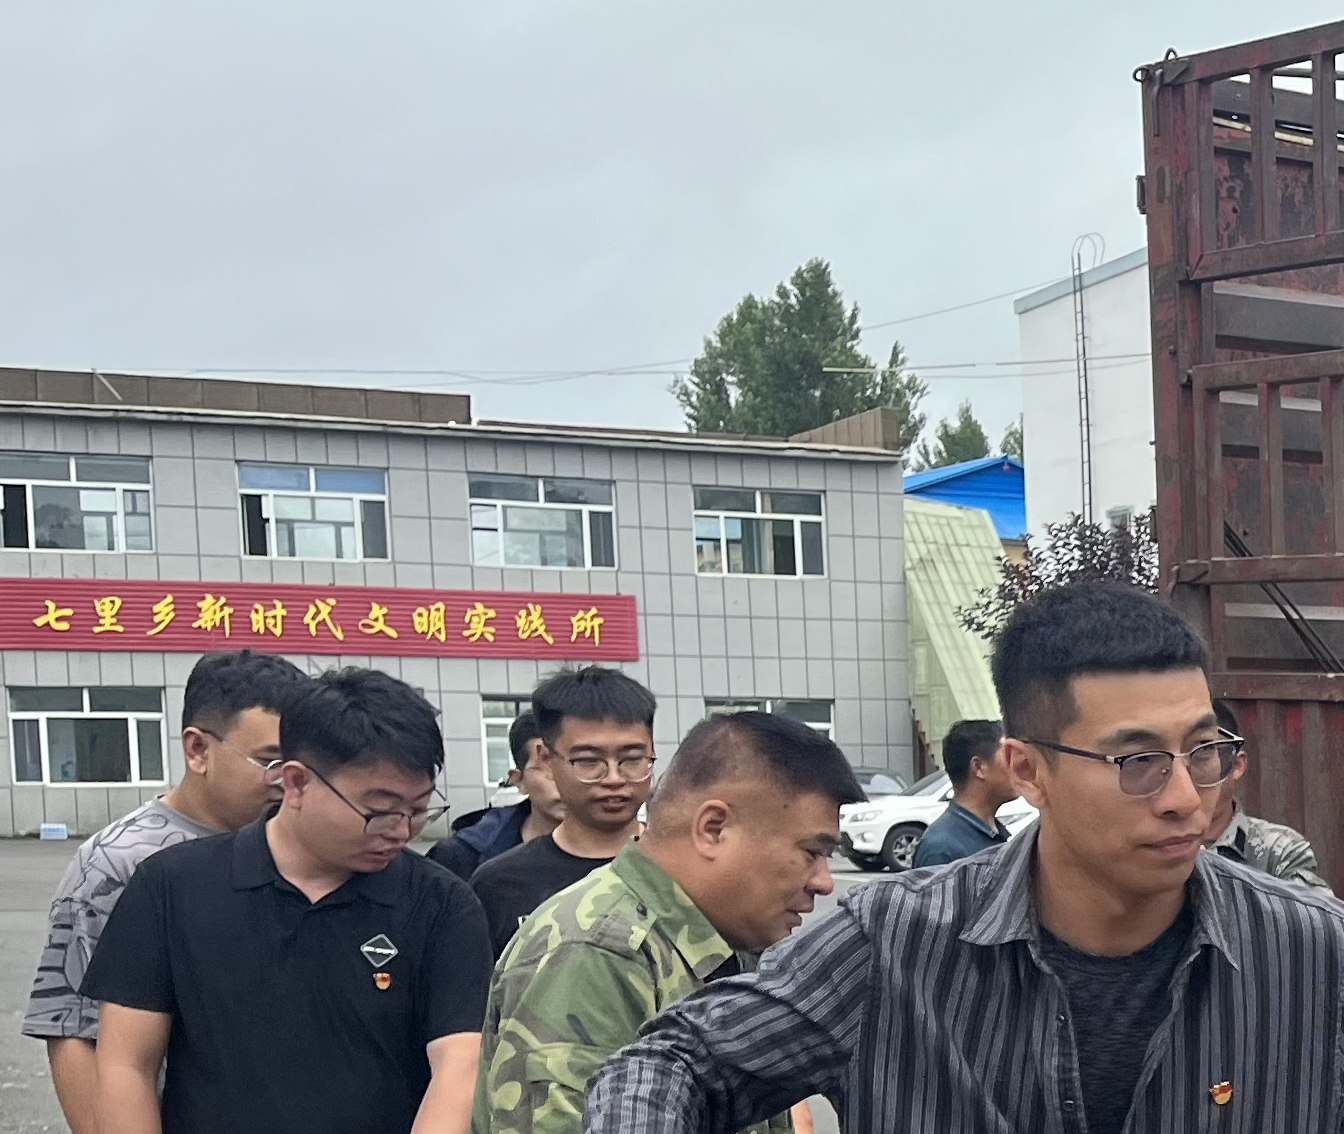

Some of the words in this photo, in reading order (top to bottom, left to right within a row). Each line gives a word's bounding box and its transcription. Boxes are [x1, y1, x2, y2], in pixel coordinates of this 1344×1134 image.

[32, 593, 605, 647] 七里乡新时代文明实践所
